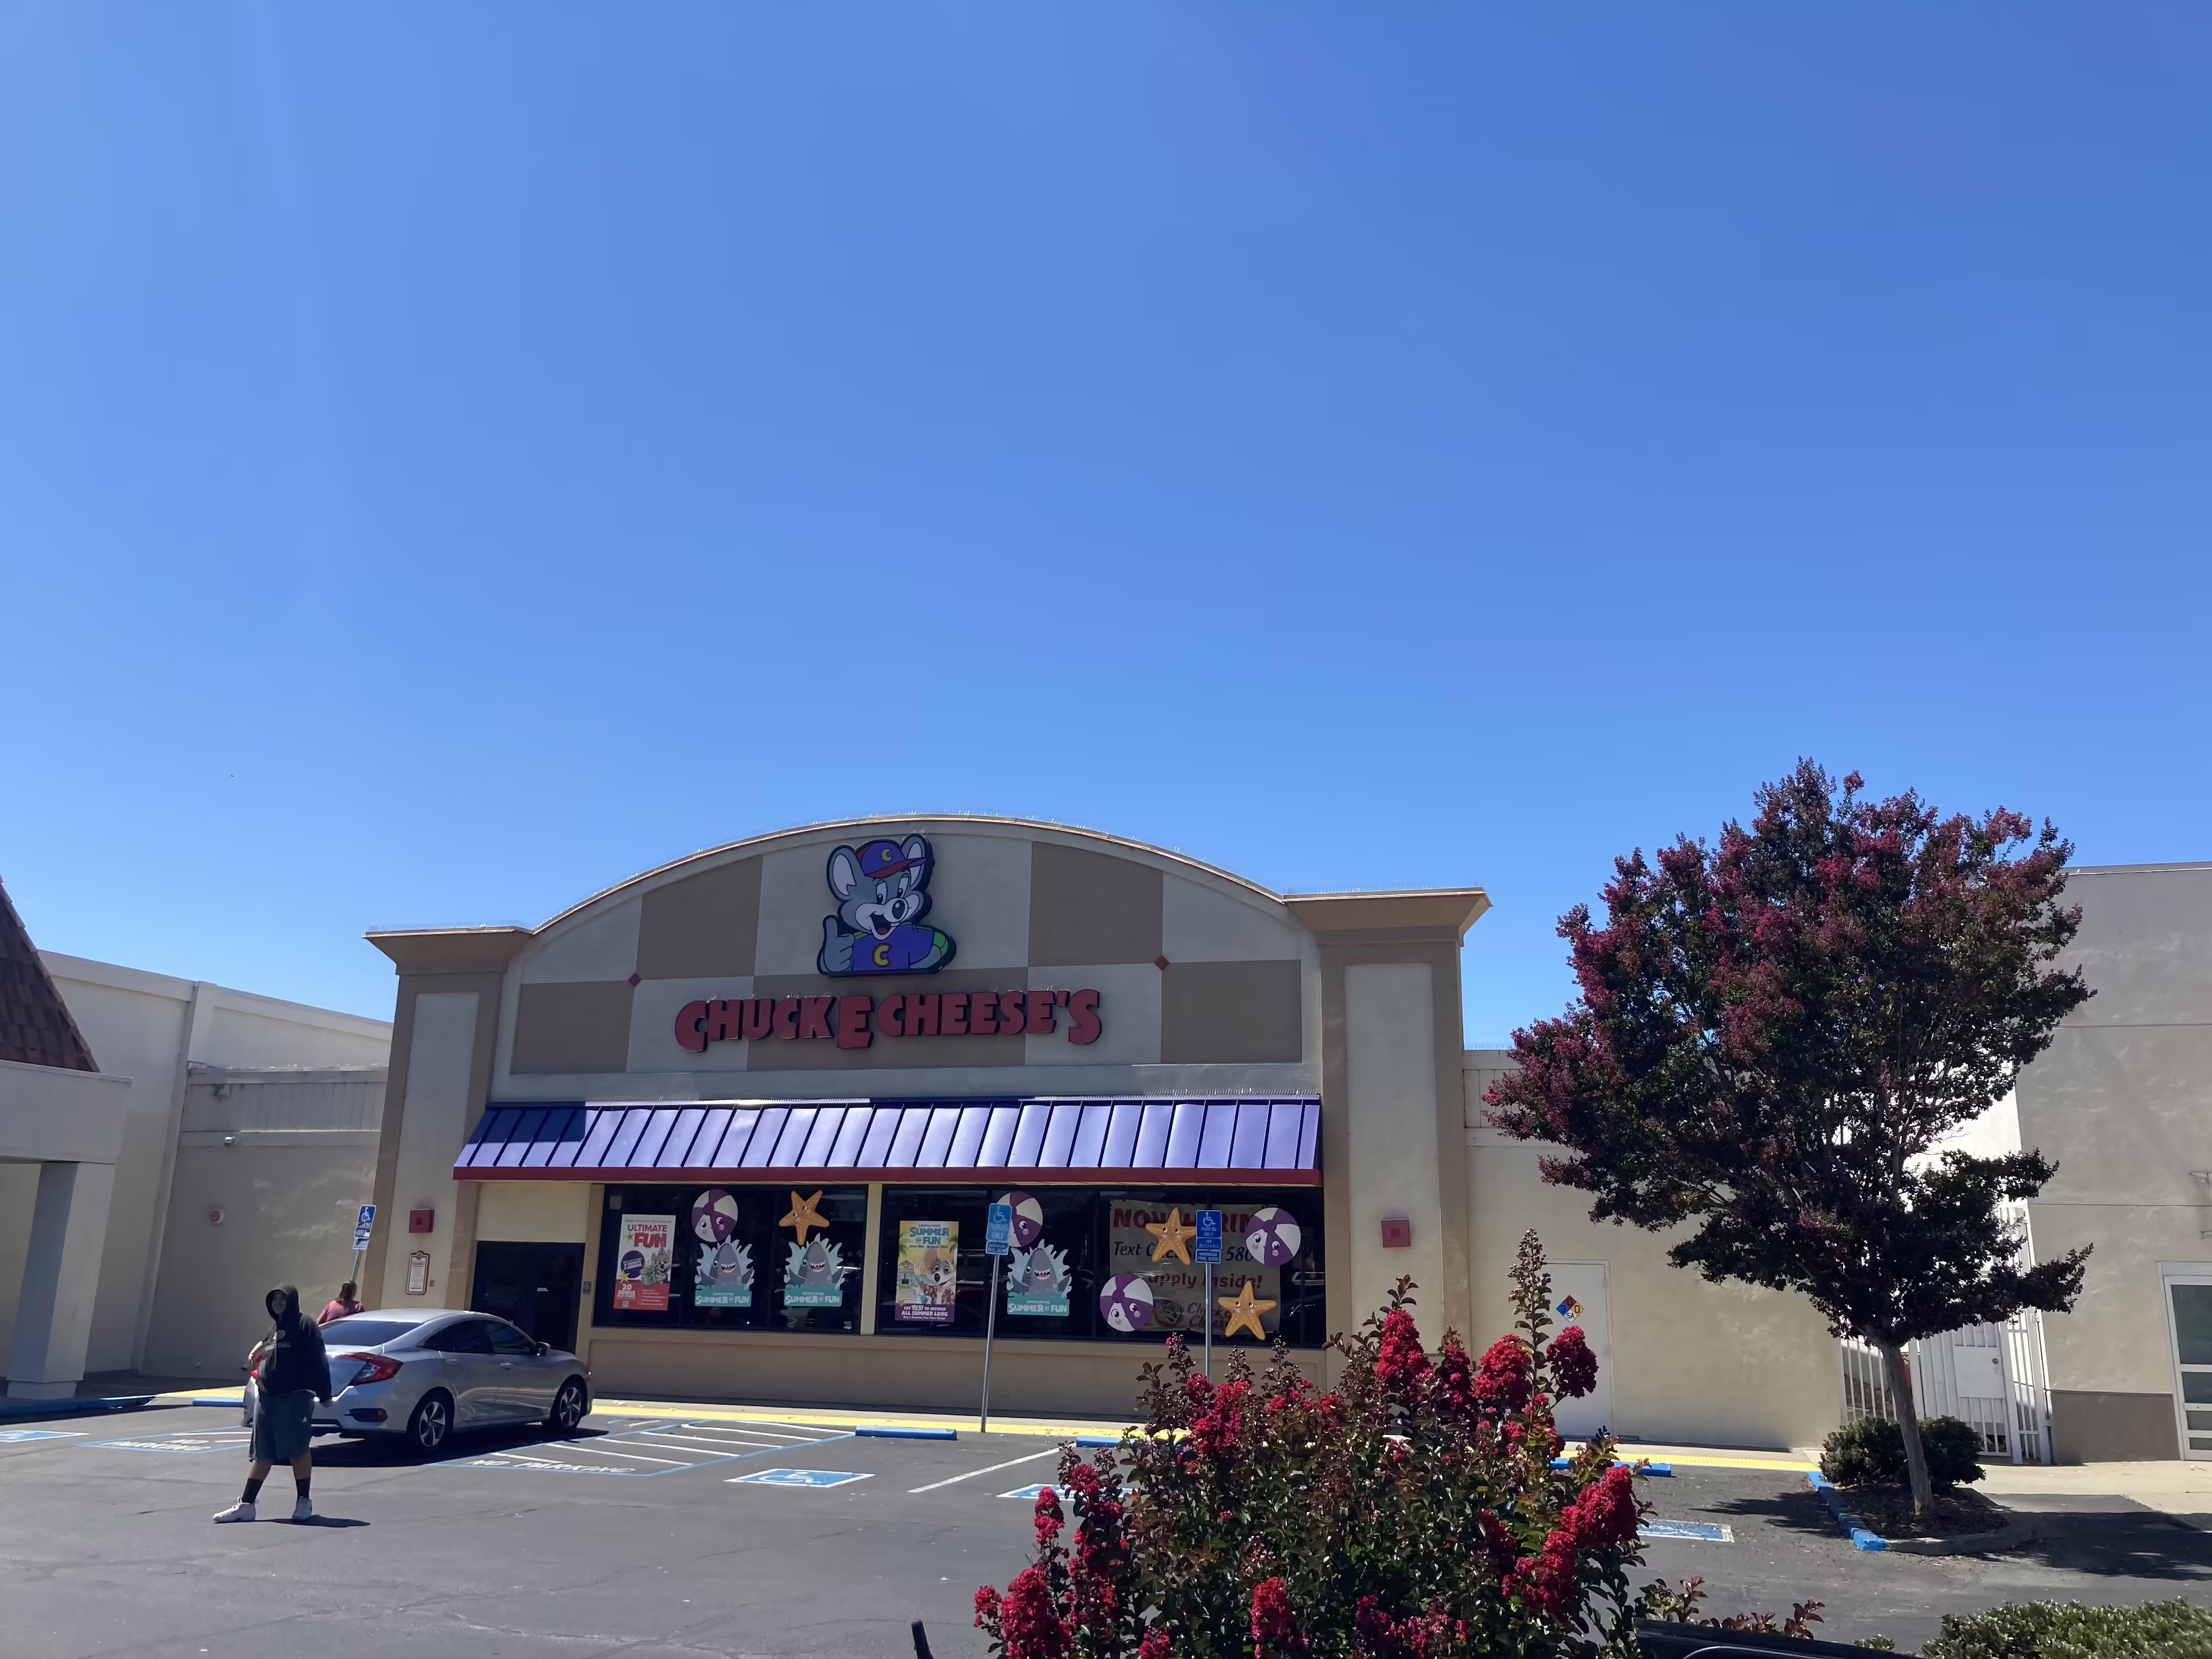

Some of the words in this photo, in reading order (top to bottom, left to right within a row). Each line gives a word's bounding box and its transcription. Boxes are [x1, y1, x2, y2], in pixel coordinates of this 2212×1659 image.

[881, 848, 893, 862] C
[872, 943, 892, 967] C
[674, 995, 836, 1052] CHUCK
[837, 995, 874, 1049] E
[878, 989, 1102, 1046] CHEESE'S
[628, 1224, 668, 1232] ULTIMATE
[910, 1227, 949, 1237] SUMMER
[989, 1222, 1008, 1232] PARKING
[634, 1232, 667, 1248] FUN
[1114, 1242, 1141, 1256] Text
[1148, 1273, 1197, 1289] apply
[696, 1295, 728, 1304] SUMMER
[785, 1295, 818, 1304] SUMMER
[1008, 1303, 1044, 1312] SUMMER
[1560, 1305, 1566, 1313] 3
[511, 1462, 635, 1472] PARKING
